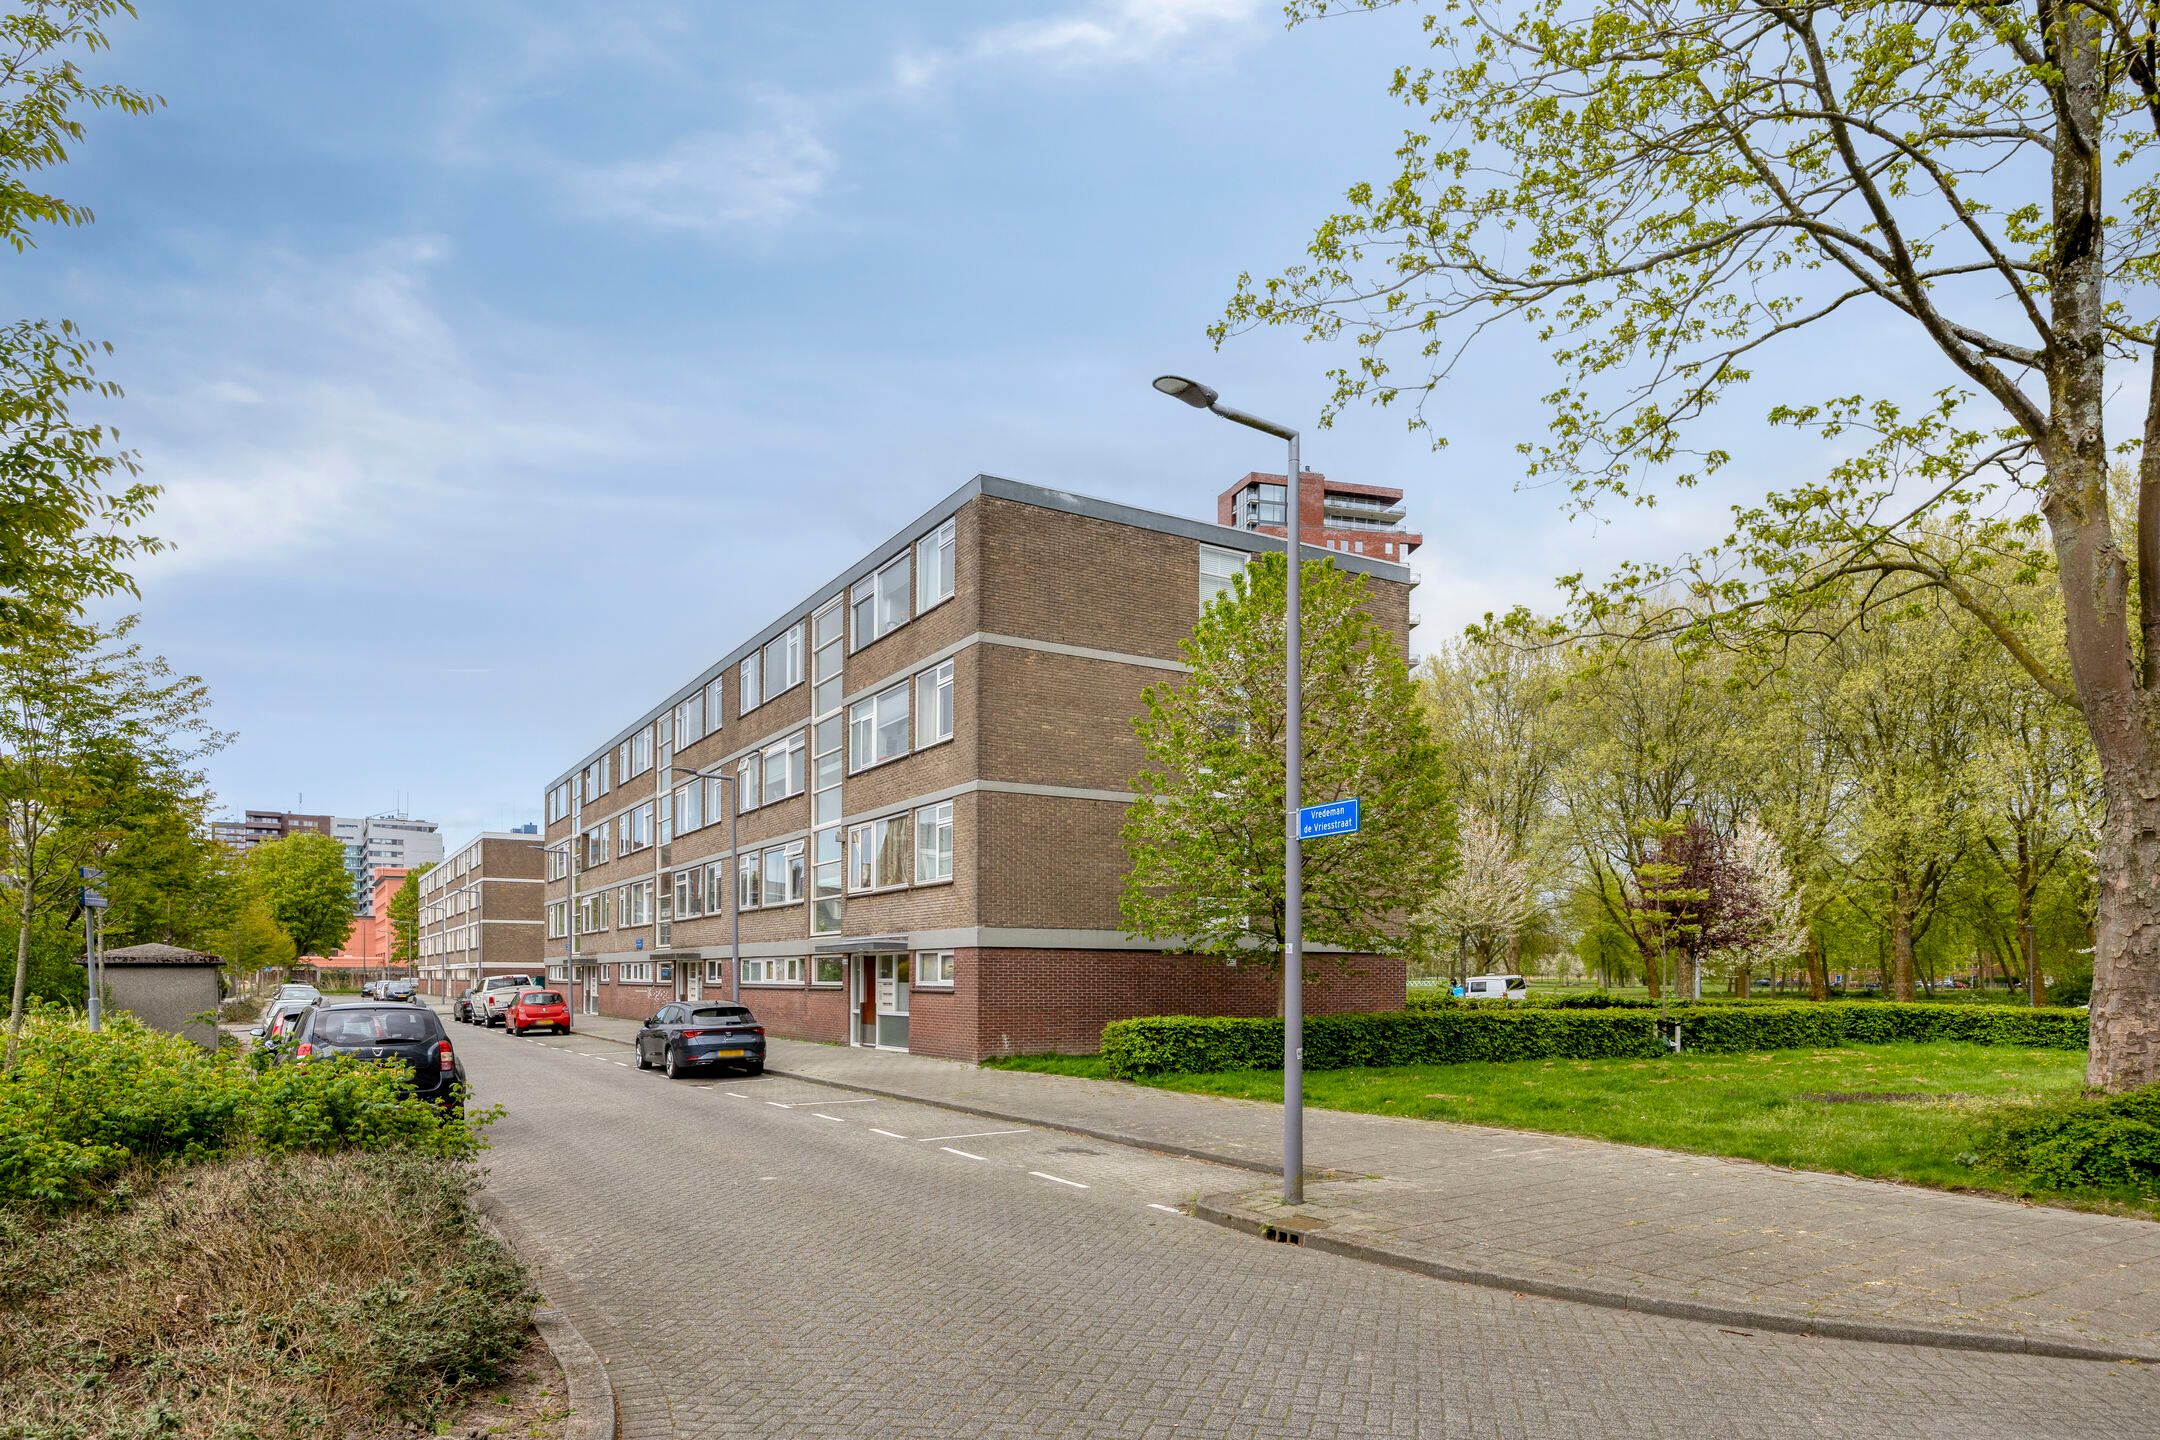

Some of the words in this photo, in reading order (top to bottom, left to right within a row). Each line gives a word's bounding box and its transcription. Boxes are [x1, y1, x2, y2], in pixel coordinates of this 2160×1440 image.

[1310, 807, 1345, 819] Vredeman
[1303, 824, 1312, 833] de
[1313, 818, 1352, 832] Vriesstraat
